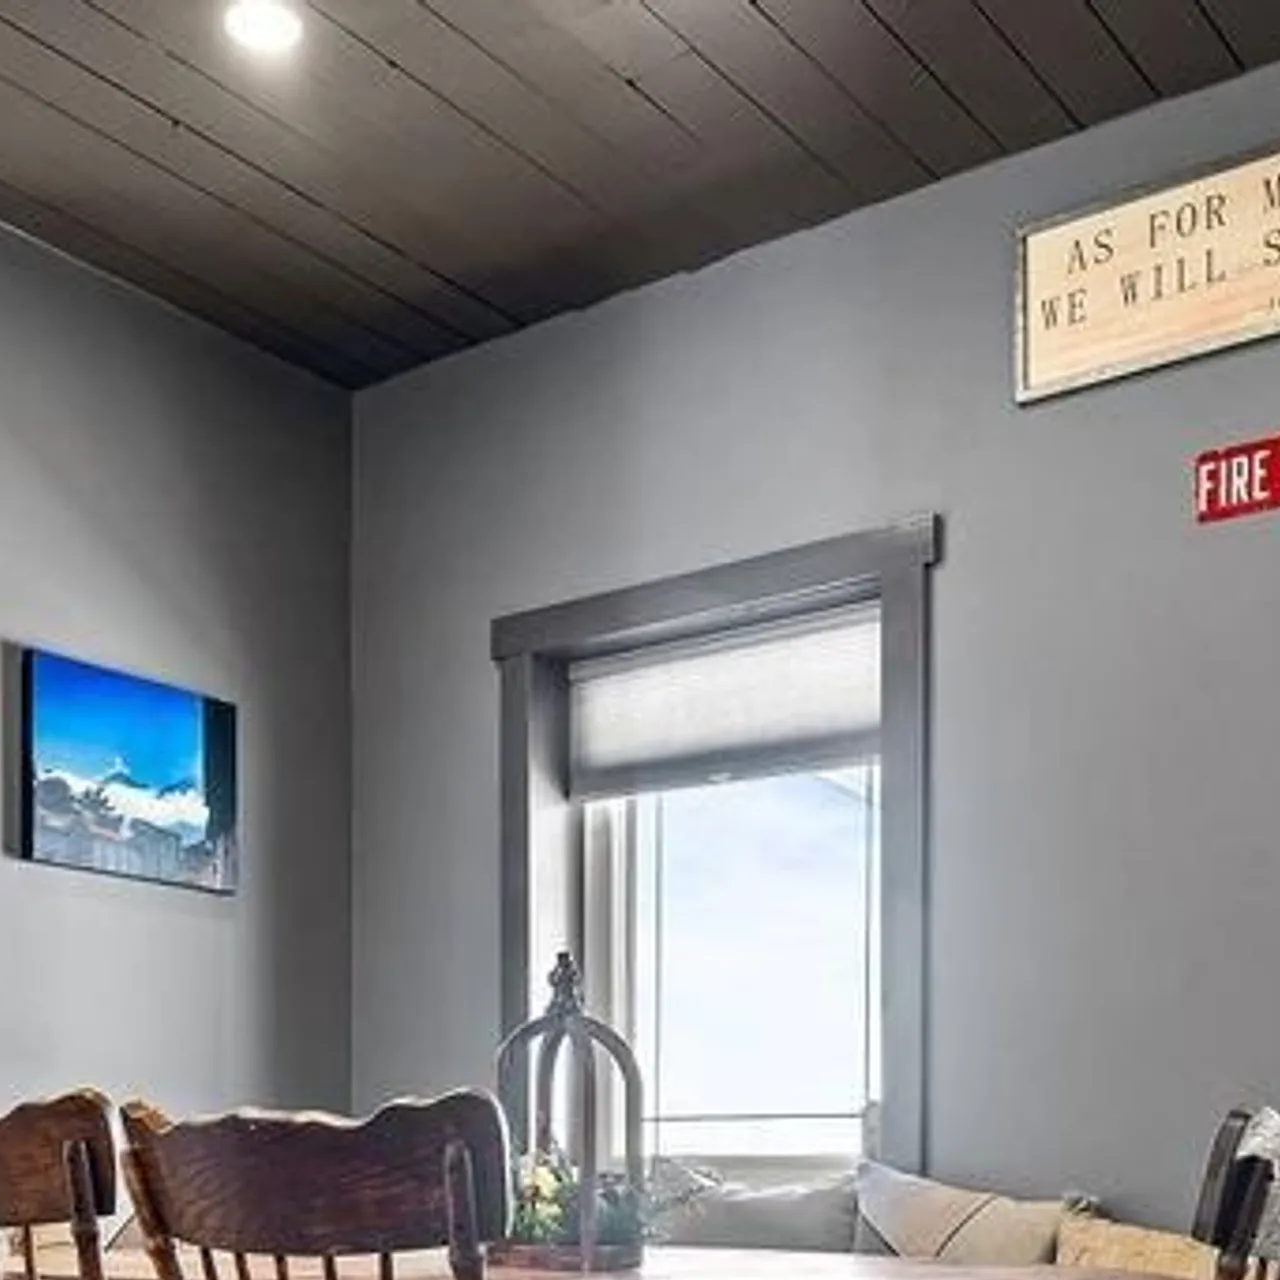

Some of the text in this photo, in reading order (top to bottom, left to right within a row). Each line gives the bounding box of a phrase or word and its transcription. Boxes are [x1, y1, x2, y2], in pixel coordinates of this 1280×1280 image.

[1066, 229, 1117, 274] AS
[1149, 193, 1228, 249] FOR
[1039, 287, 1089, 331] WE
[1119, 248, 1228, 305] WILL
[1197, 446, 1270, 513] FIRE
